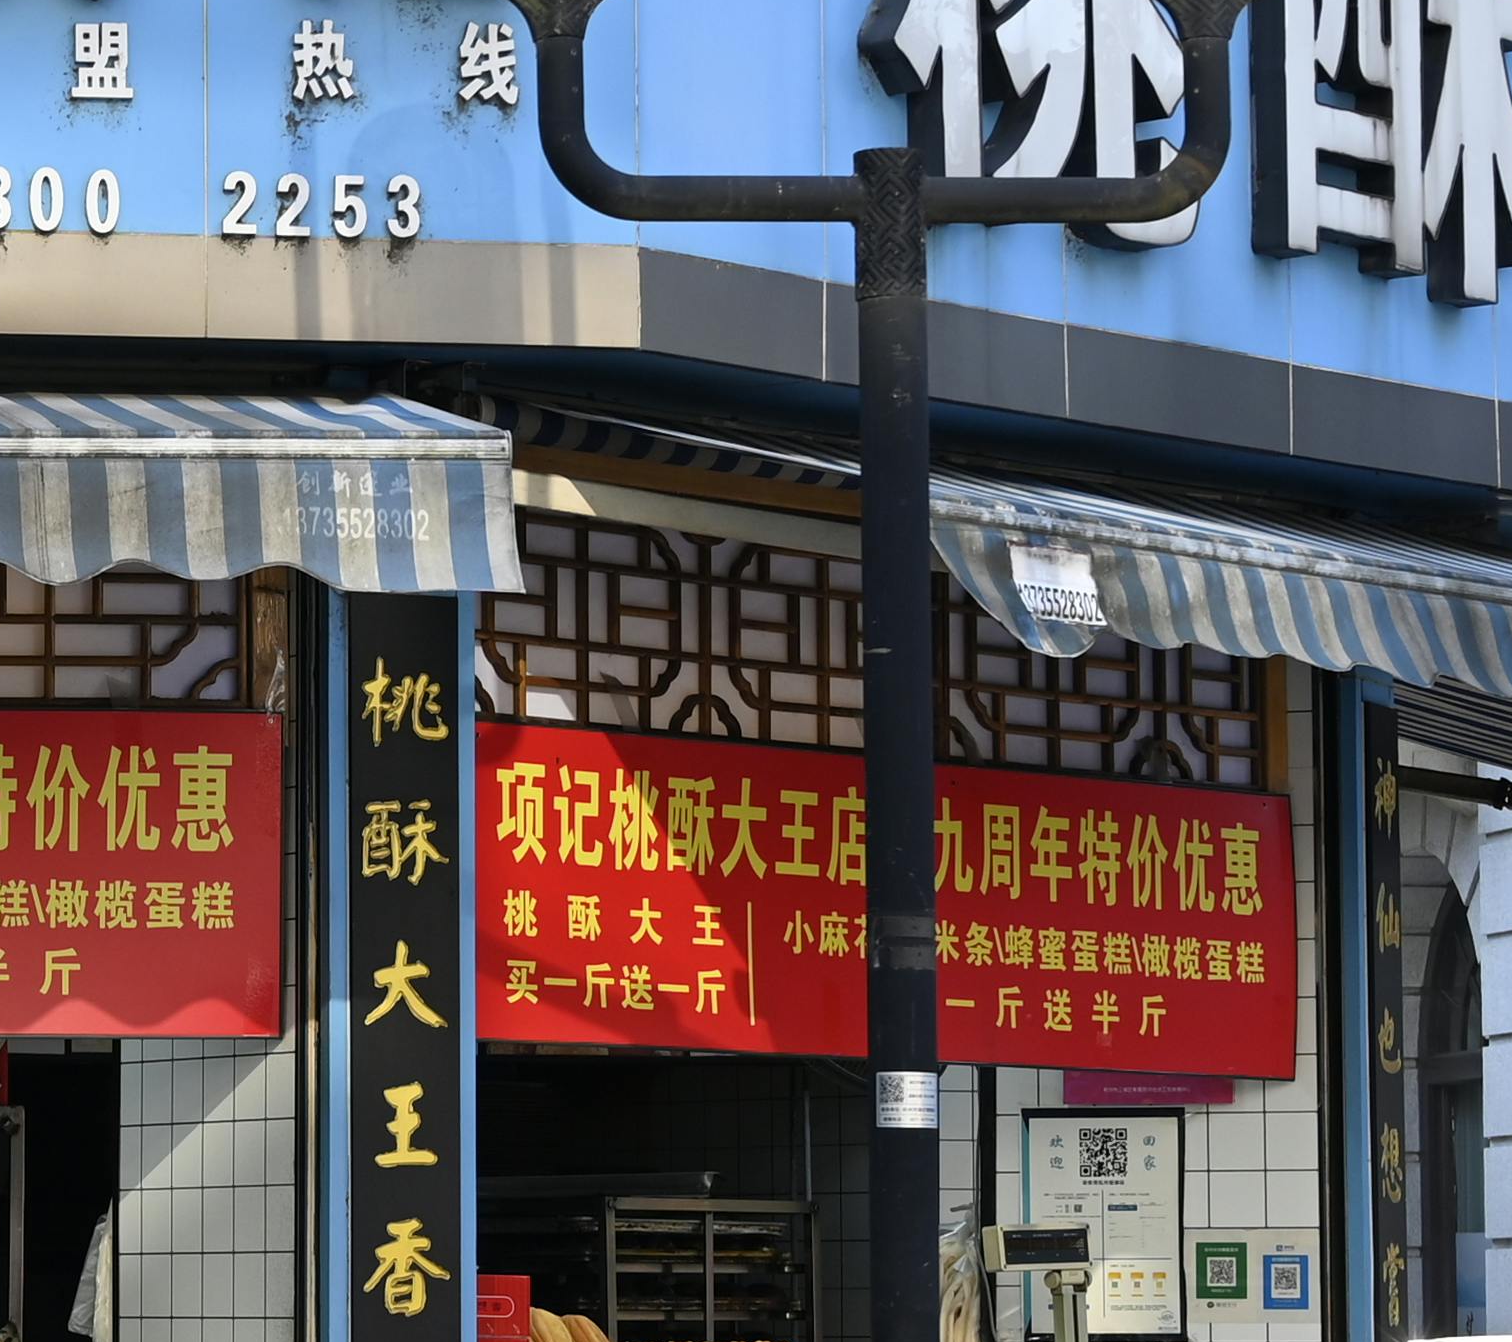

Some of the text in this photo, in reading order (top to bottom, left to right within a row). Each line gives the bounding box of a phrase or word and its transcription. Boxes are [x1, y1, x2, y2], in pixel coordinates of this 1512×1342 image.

[221, 168, 424, 244] 2253
[495, 762, 1262, 917] 项记桃酥大王店九周年特价优惠
[502, 888, 727, 949] 桃酥大王
[358, 655, 453, 1320] 桃酥大王香
[504, 958, 727, 1016] 买一斤送一斤
[945, 985, 1169, 1039] 一斤送半斤
